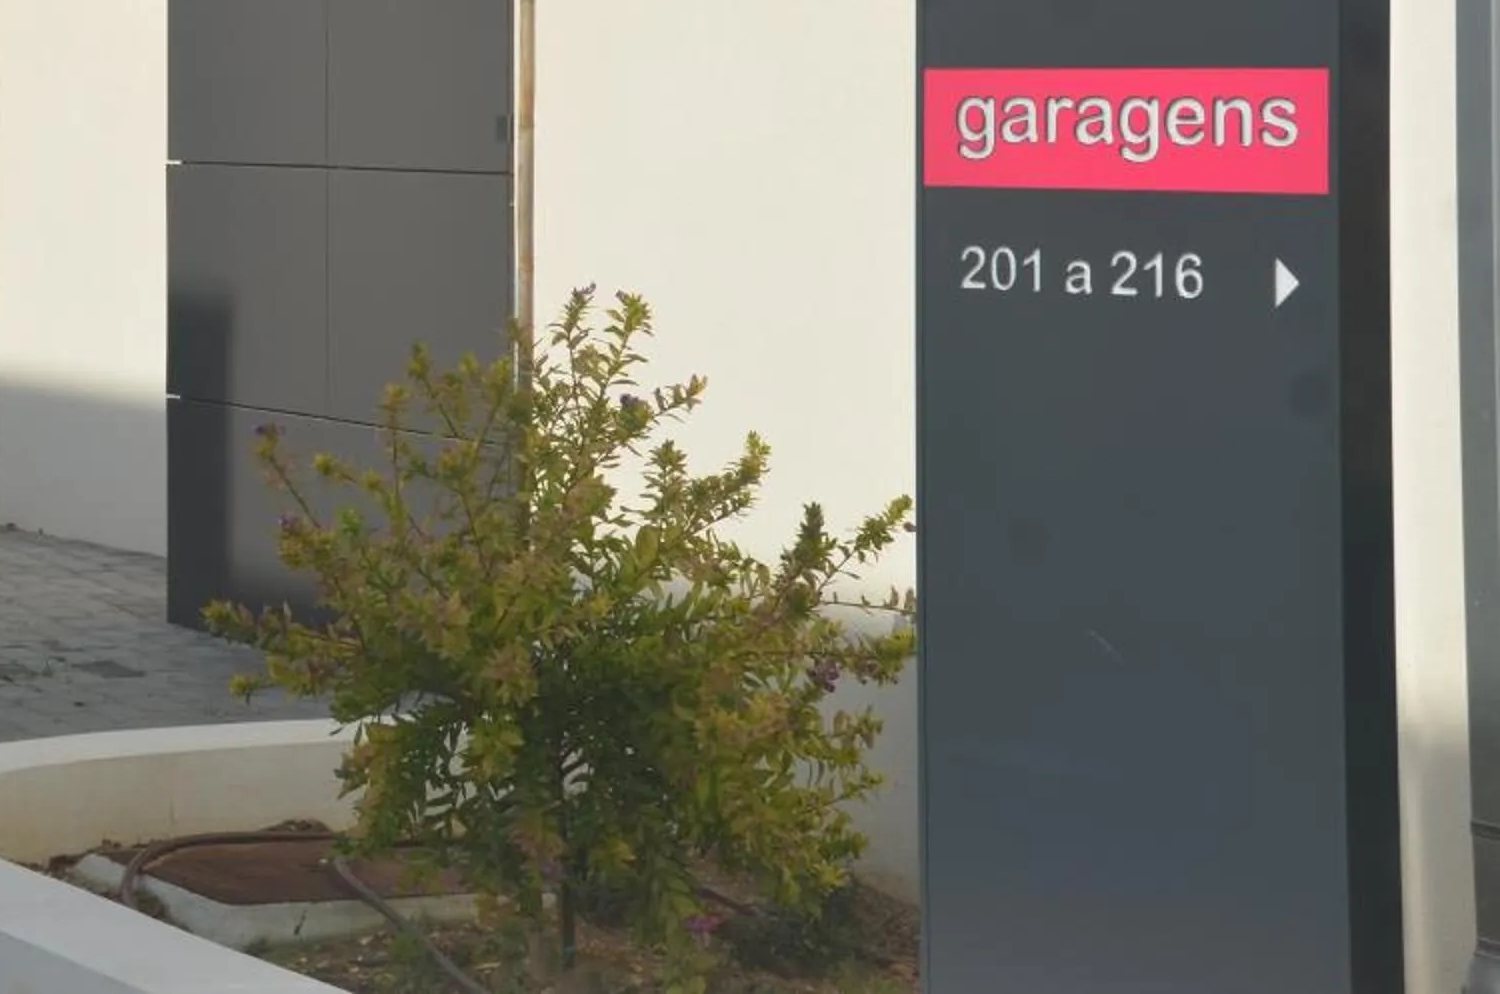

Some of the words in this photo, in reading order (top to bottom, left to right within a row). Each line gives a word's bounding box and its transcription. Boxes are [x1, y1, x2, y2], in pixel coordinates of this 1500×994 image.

[956, 95, 1300, 163] garagens
[959, 245, 1042, 293] 201
[1064, 259, 1094, 296] a
[1109, 250, 1205, 300] 216
